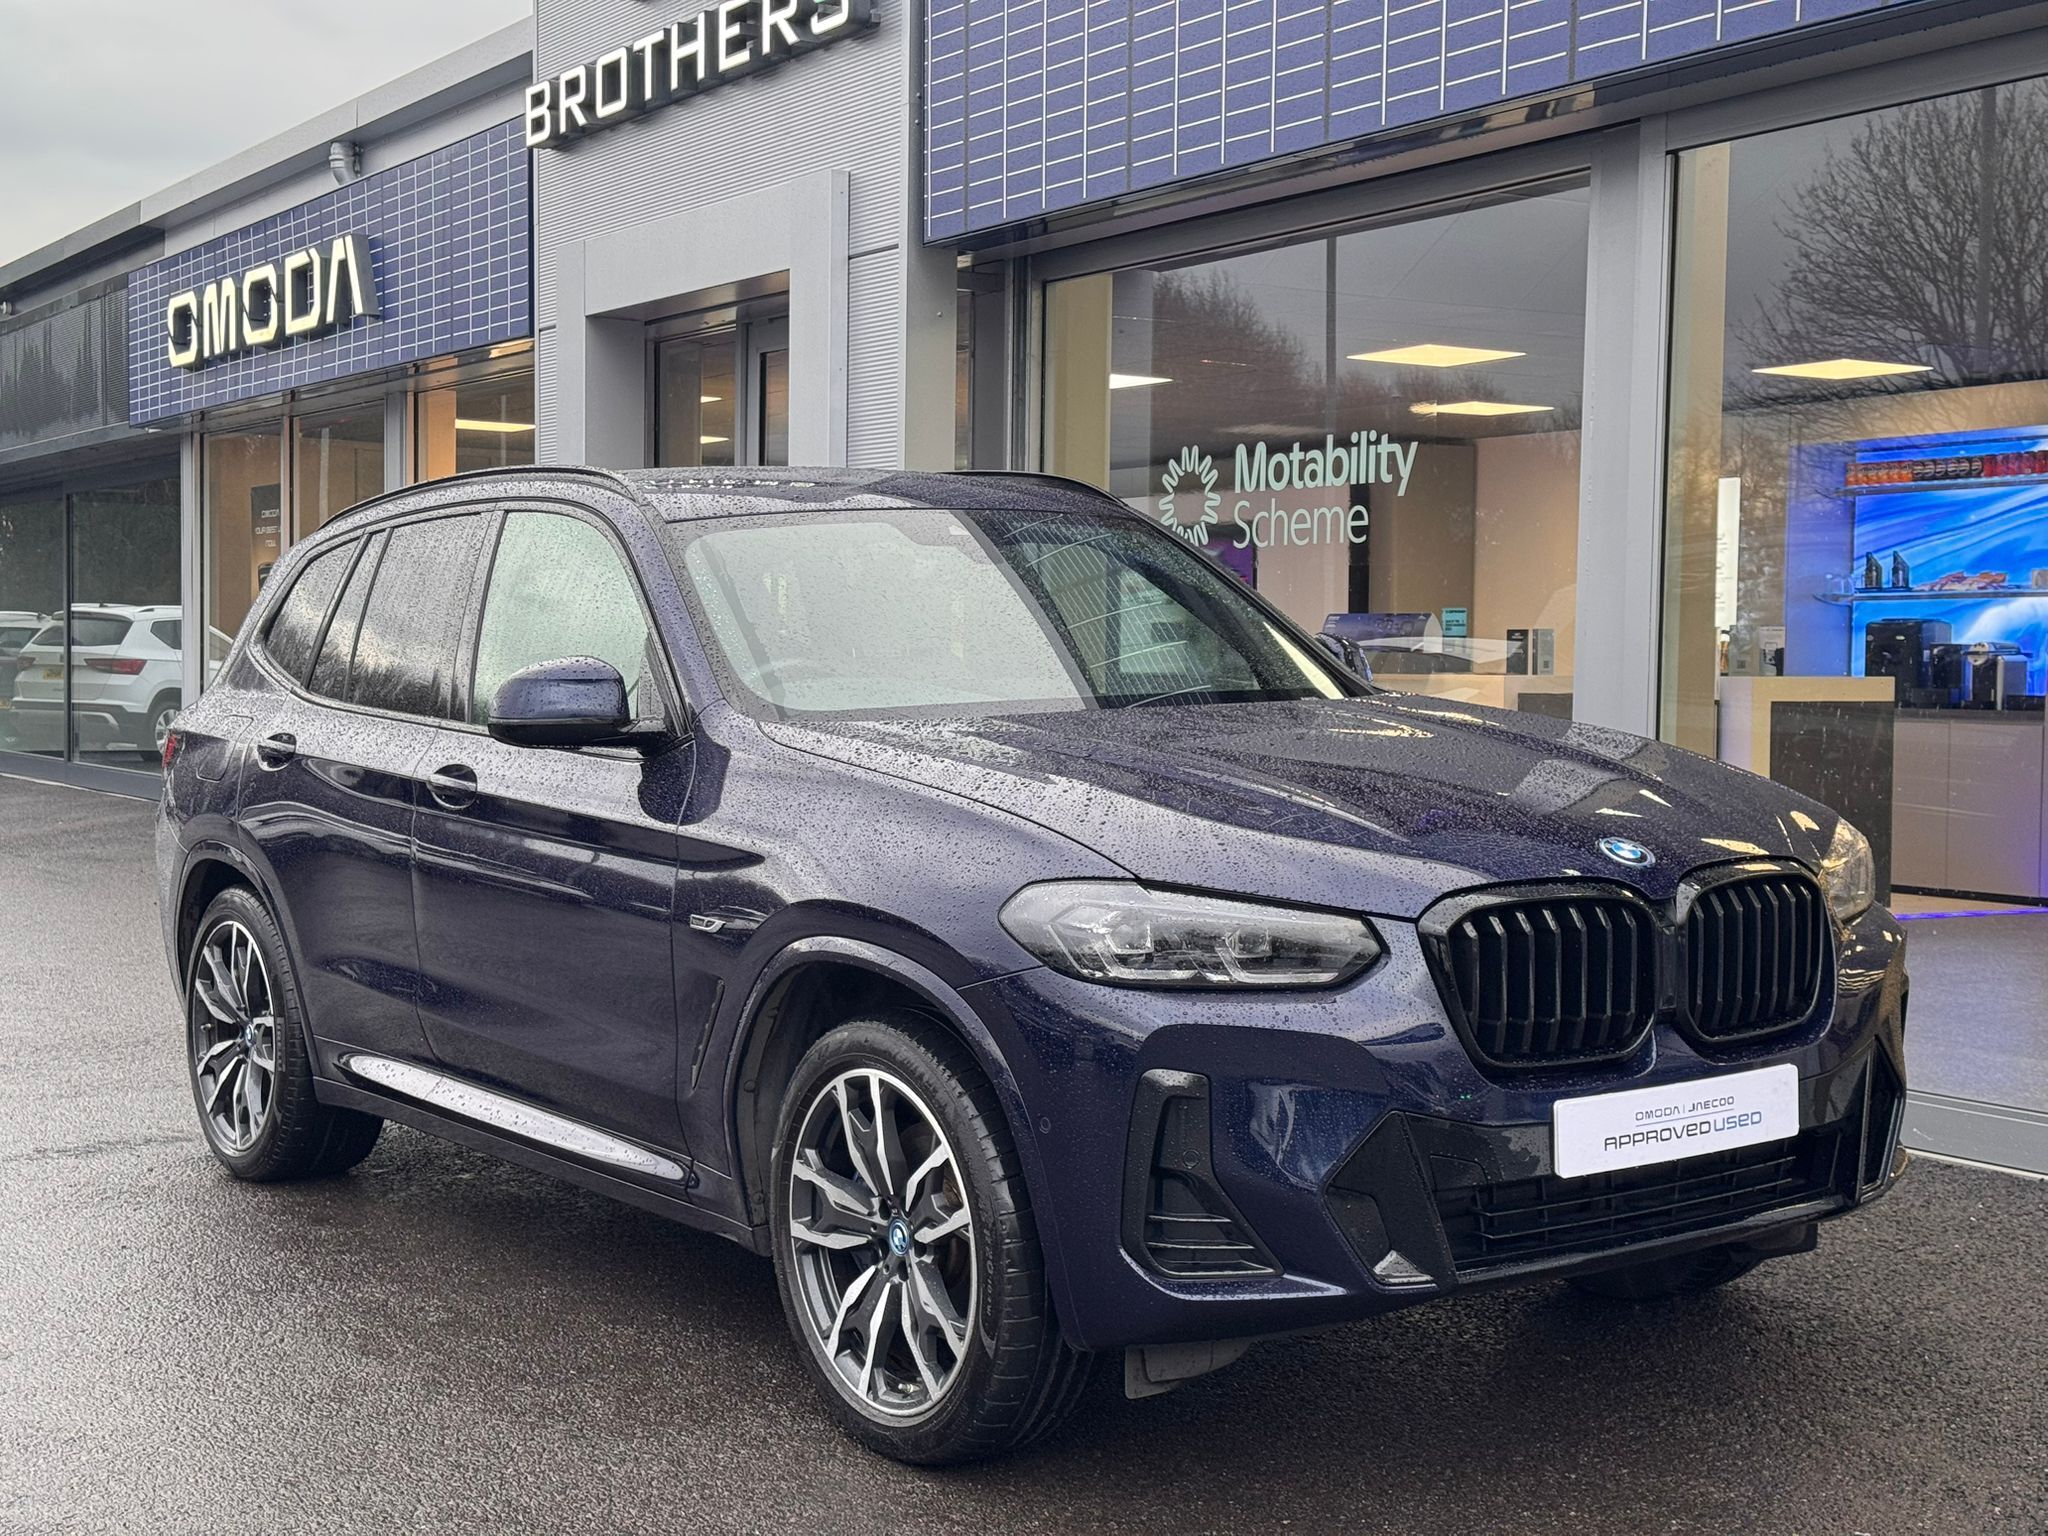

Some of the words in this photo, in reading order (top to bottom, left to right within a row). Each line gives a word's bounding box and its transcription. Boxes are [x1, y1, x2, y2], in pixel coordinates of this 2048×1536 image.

[167, 235, 364, 368] OMODA
[1234, 430, 1419, 496] Motability
[1233, 498, 1369, 549] Scheme
[1635, 1105, 1680, 1121] OMODA
[1688, 1096, 1735, 1112] JAECOO
